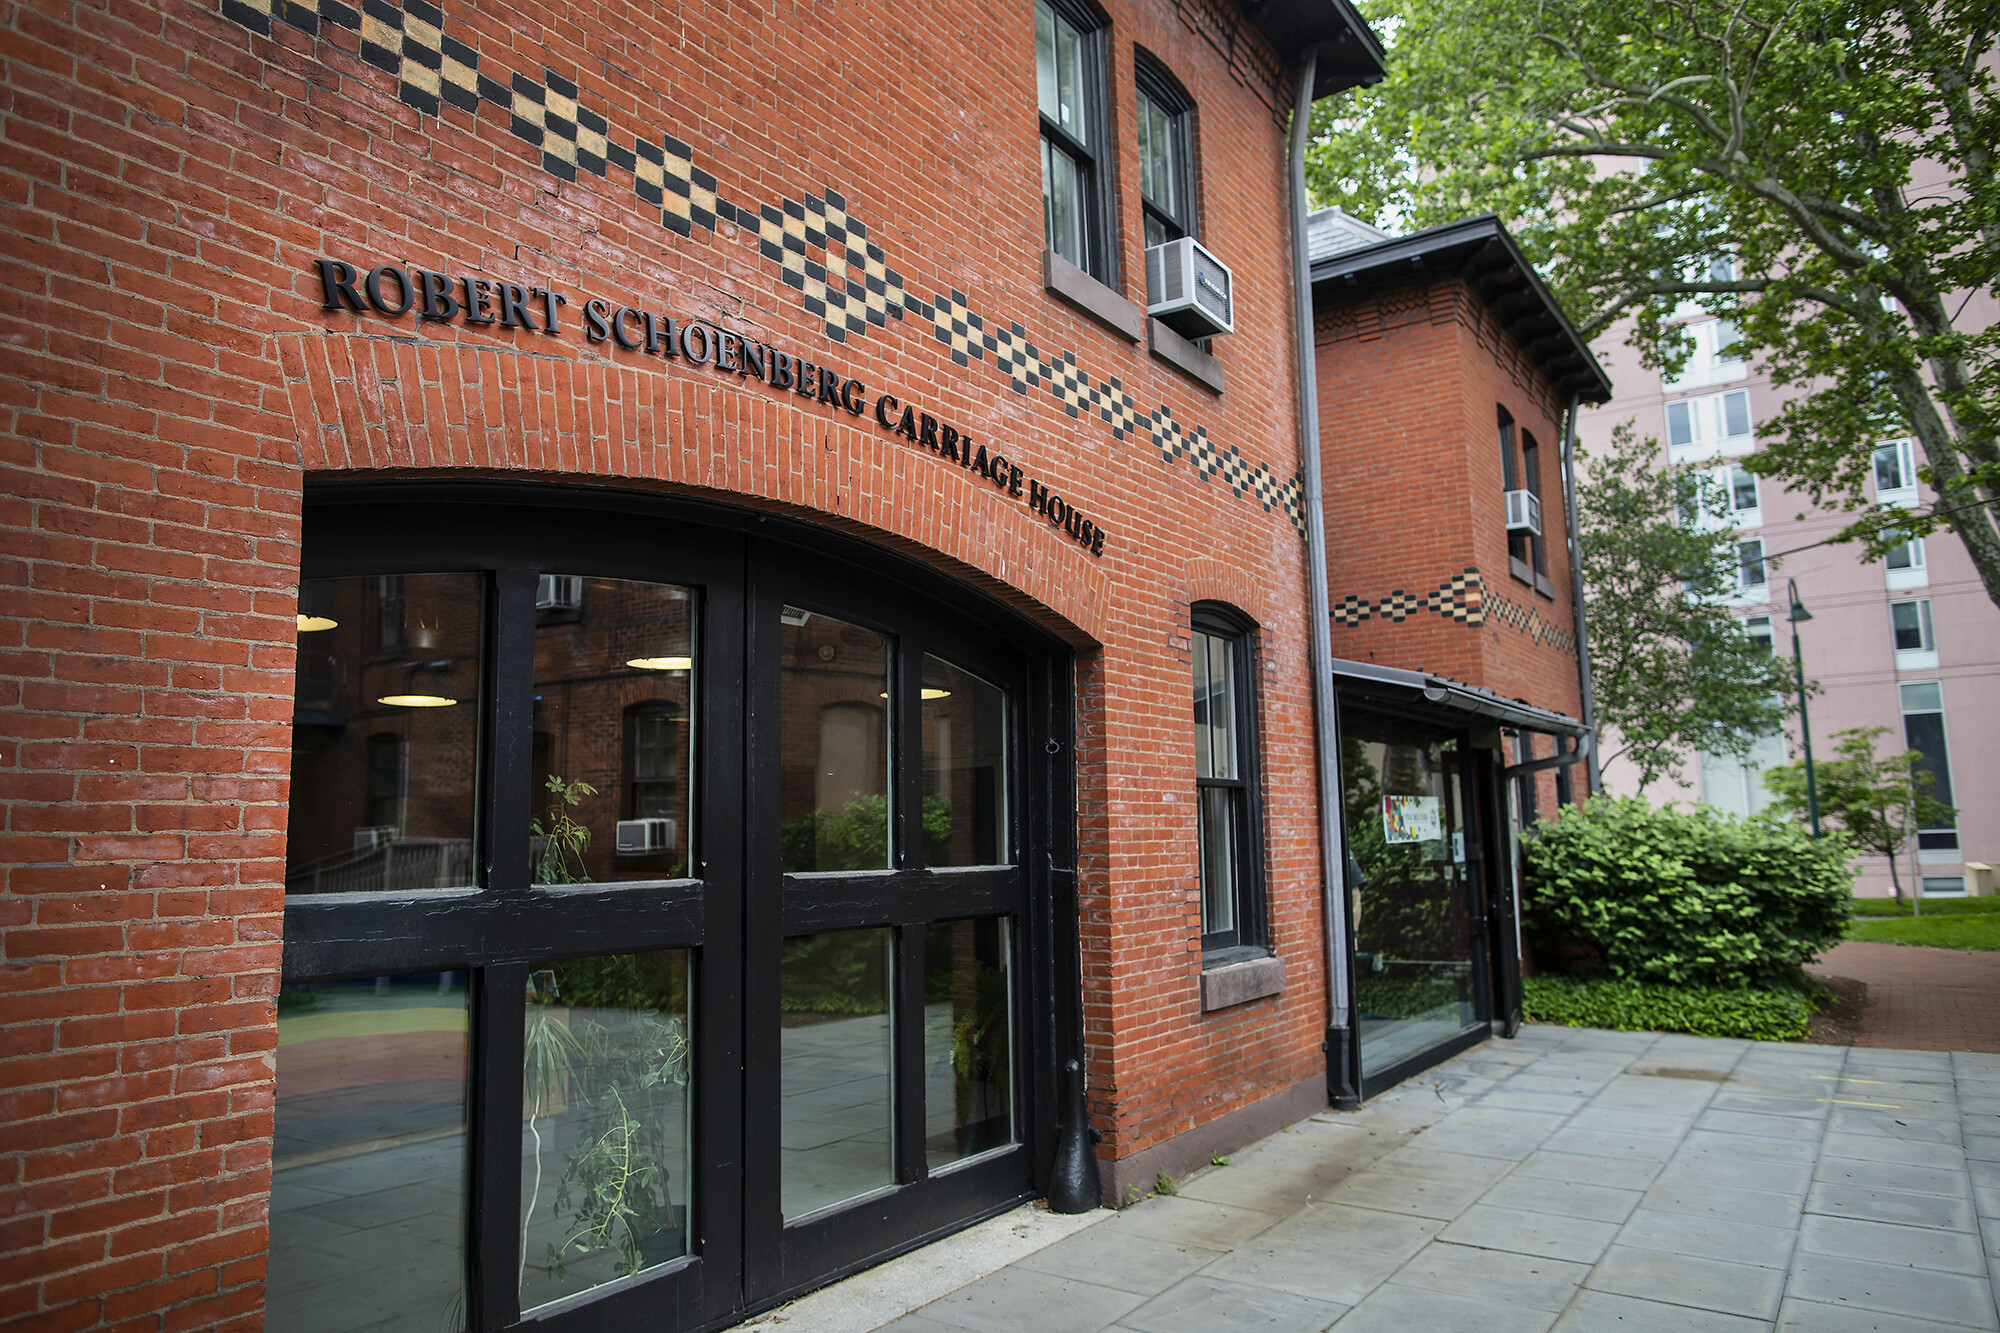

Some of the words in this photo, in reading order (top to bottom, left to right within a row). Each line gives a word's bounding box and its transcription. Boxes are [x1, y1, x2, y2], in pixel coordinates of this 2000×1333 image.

[314, 259, 567, 334] ROBERT
[584, 299, 866, 415] SCHOENBERG
[876, 394, 1024, 497] CARRIAGE
[1029, 478, 1106, 557] HOUSE
